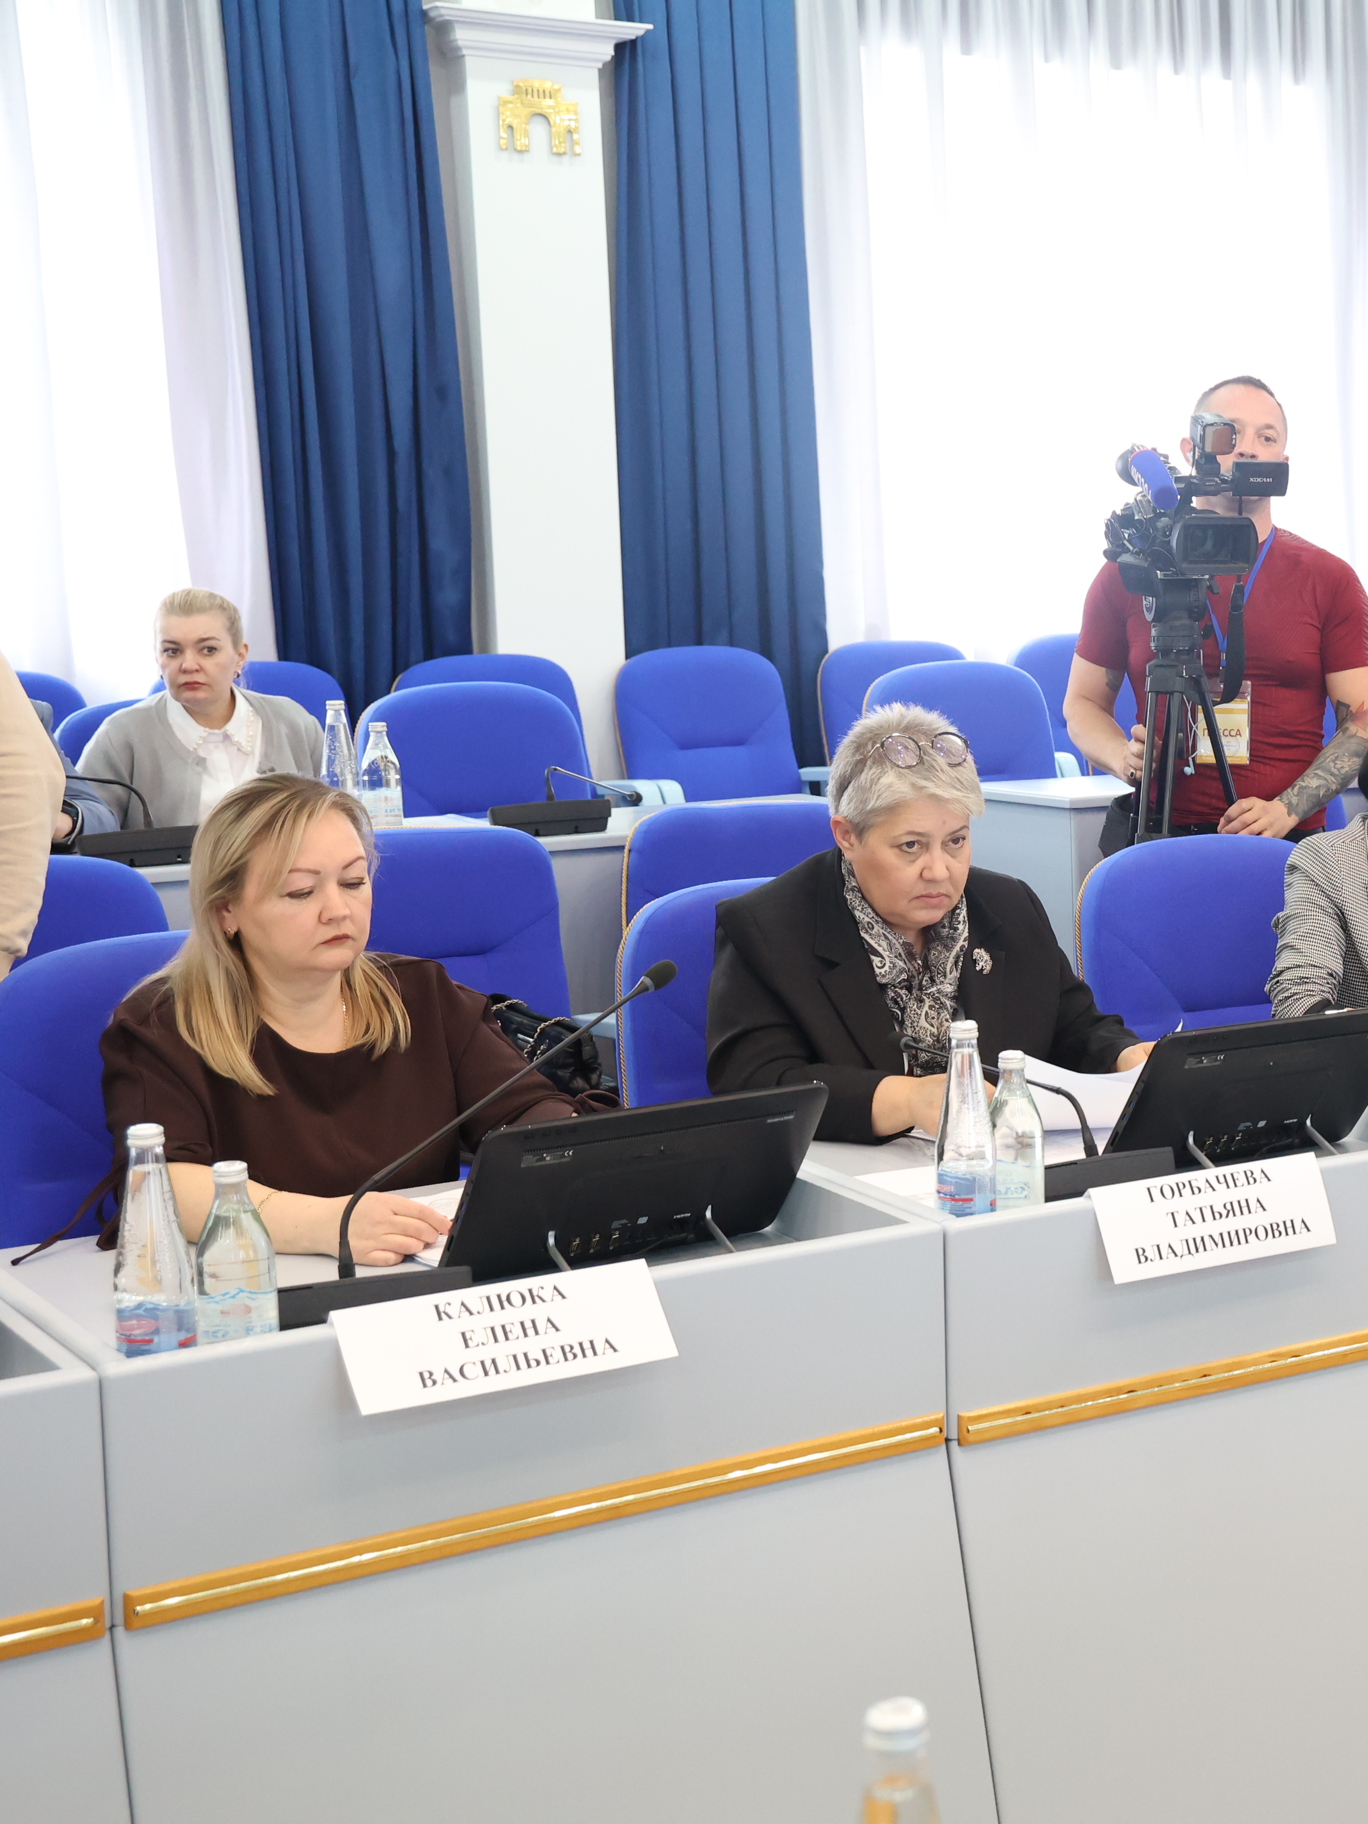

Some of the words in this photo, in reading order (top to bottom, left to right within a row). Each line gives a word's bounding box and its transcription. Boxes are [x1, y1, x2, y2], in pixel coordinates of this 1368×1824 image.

[1202, 728, 1242, 737] ПССА
[1146, 1167, 1273, 1204] ГОРБАЧЕВА
[1165, 1196, 1268, 1229] ТАТЬЯНА
[1133, 1217, 1312, 1265] ВЛАДИМИРОВНА
[433, 1284, 567, 1322] КАЛЮКА
[459, 1315, 562, 1350] ЕЛЕНА
[417, 1336, 620, 1390] ВАСИЛЬЕВНА
